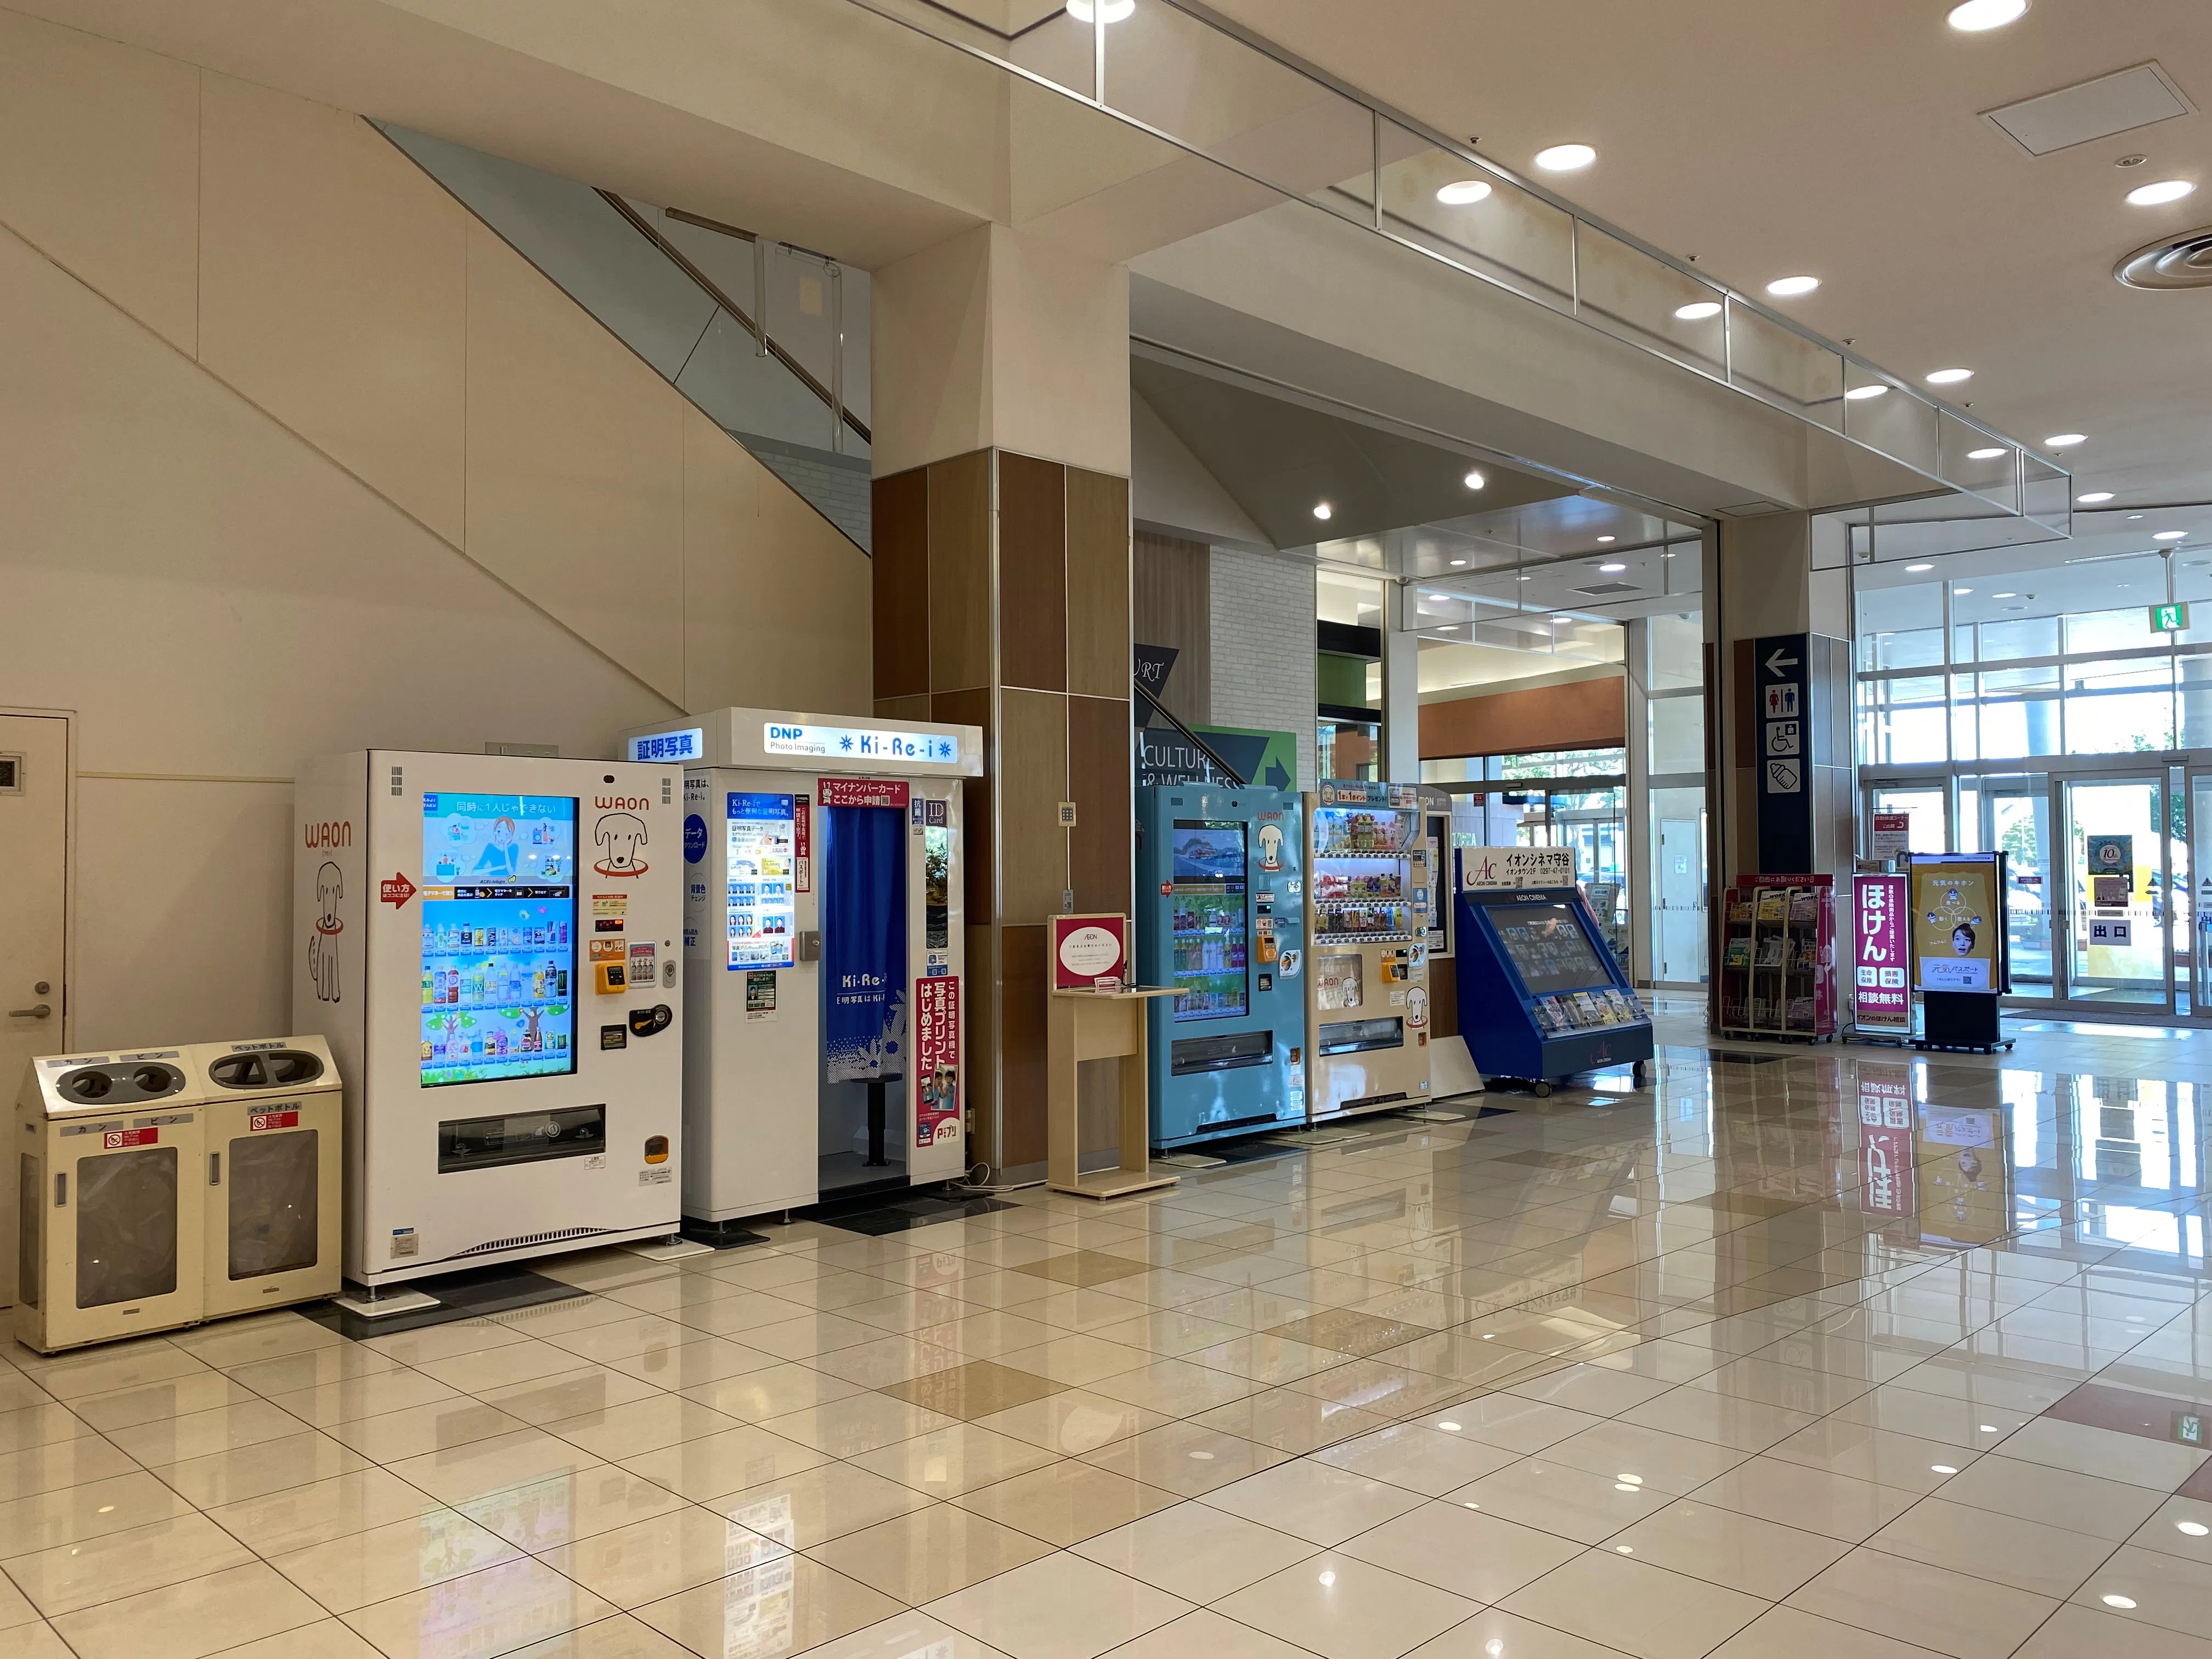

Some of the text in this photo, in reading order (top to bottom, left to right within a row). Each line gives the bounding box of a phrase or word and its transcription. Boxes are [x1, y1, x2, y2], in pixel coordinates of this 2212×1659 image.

[770, 727, 803, 740] DNP
[637, 735, 693, 760] 証明写真
[770, 742, 826, 754] Photo Imaging
[861, 735, 933, 758] Ki-Re-i
[833, 783, 900, 794] マイナンバーカード
[595, 796, 649, 810] WAON
[834, 795, 881, 805] ここから申請
[914, 799, 922, 816] 抗菌
[929, 803, 944, 816] ID
[1257, 812, 1284, 821] WAON
[305, 821, 351, 848] WAON
[685, 827, 702, 839] データ
[1506, 853, 1569, 867] イオンシネマ守谷
[382, 884, 409, 893] 使い方
[691, 884, 706, 894] 背景色
[1863, 884, 1887, 961] ほけん
[2094, 925, 2126, 938] 出口
[1932, 964, 1978, 974] 元気パスポート
[1858, 991, 1904, 1005] 相談無料
[1857, 1014, 1905, 1023] イオンのほけん相談
[921, 983, 933, 1070] はじめました
[934, 981, 946, 1069] 写真プリント
[234, 1042, 284, 1051] ペットボトル
[251, 1103, 300, 1114] ペットボトル
[151, 1116, 177, 1125] ビン
[78, 1125, 107, 1133] カン
